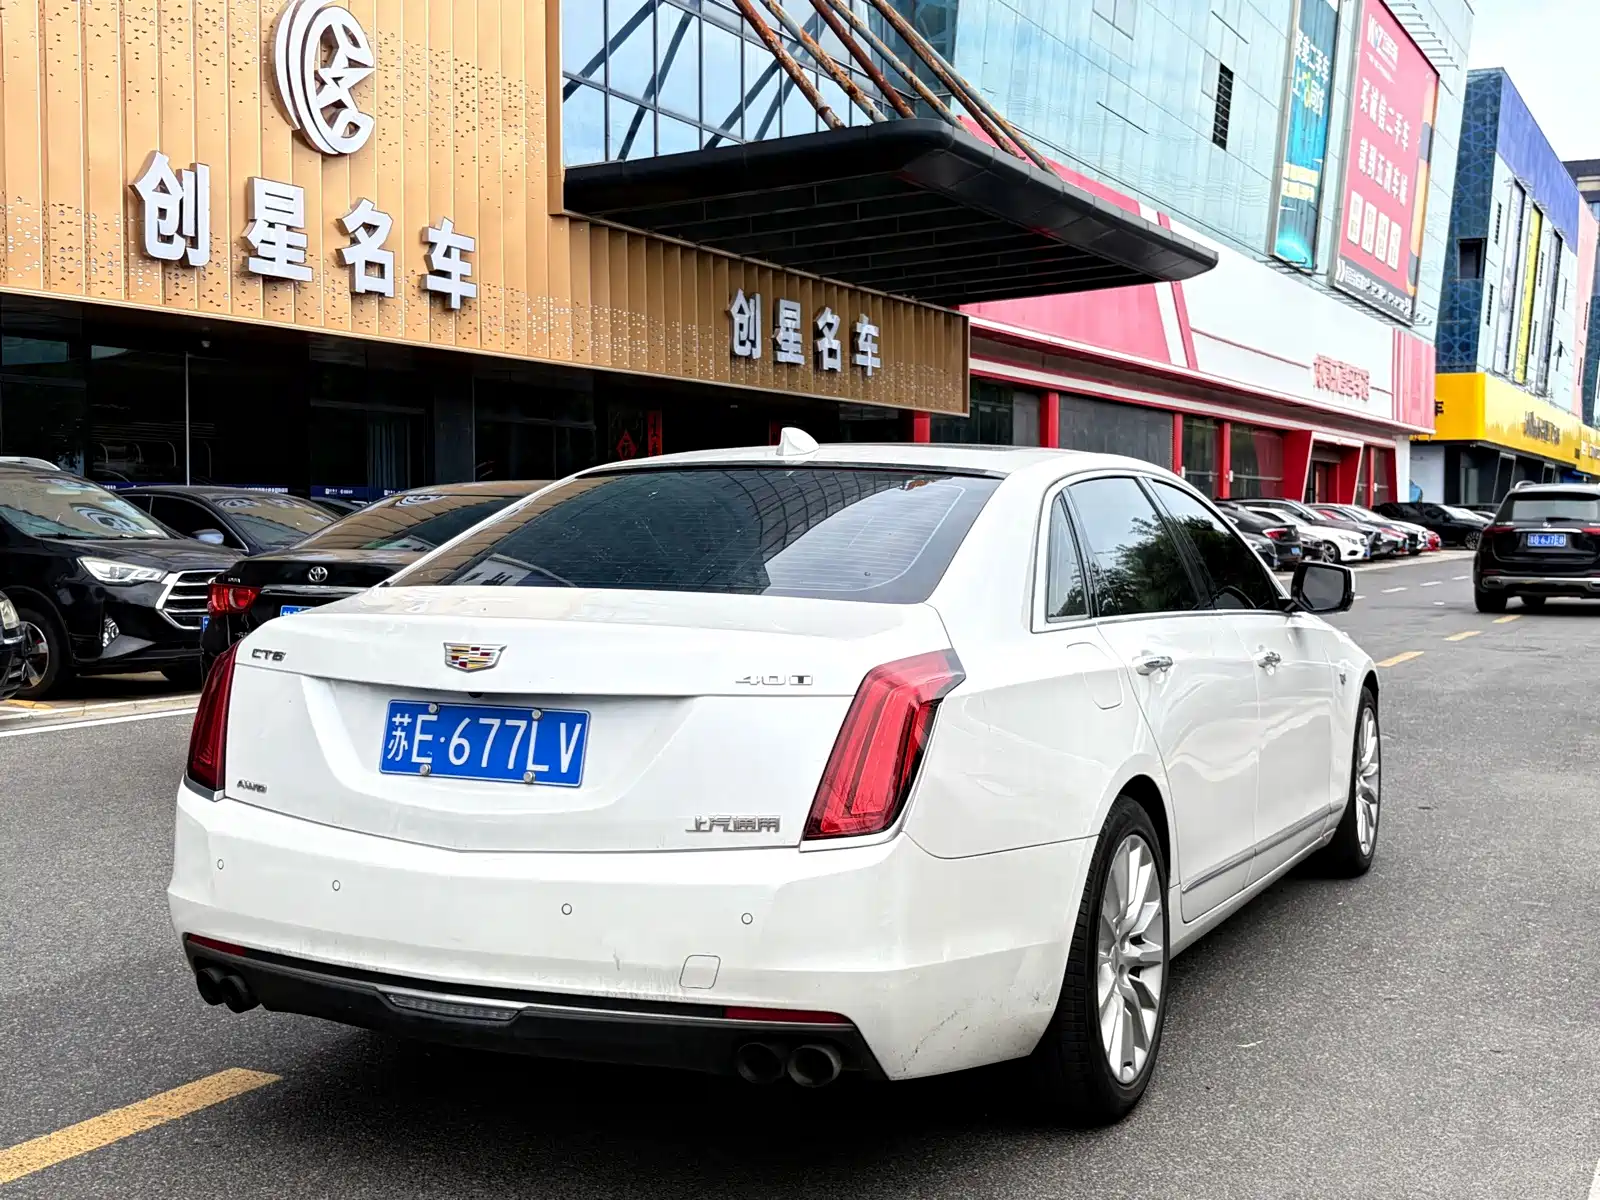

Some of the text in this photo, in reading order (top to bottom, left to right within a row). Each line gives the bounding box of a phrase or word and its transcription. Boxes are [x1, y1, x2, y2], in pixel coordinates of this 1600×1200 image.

[130, 151, 478, 311] 创星名车
[725, 288, 881, 376] 创星名车
[251, 648, 286, 662] CT6
[387, 713, 582, 773] 苏E·677LV
[236, 780, 267, 794] AWD
[685, 815, 781, 833] 上汽通用
